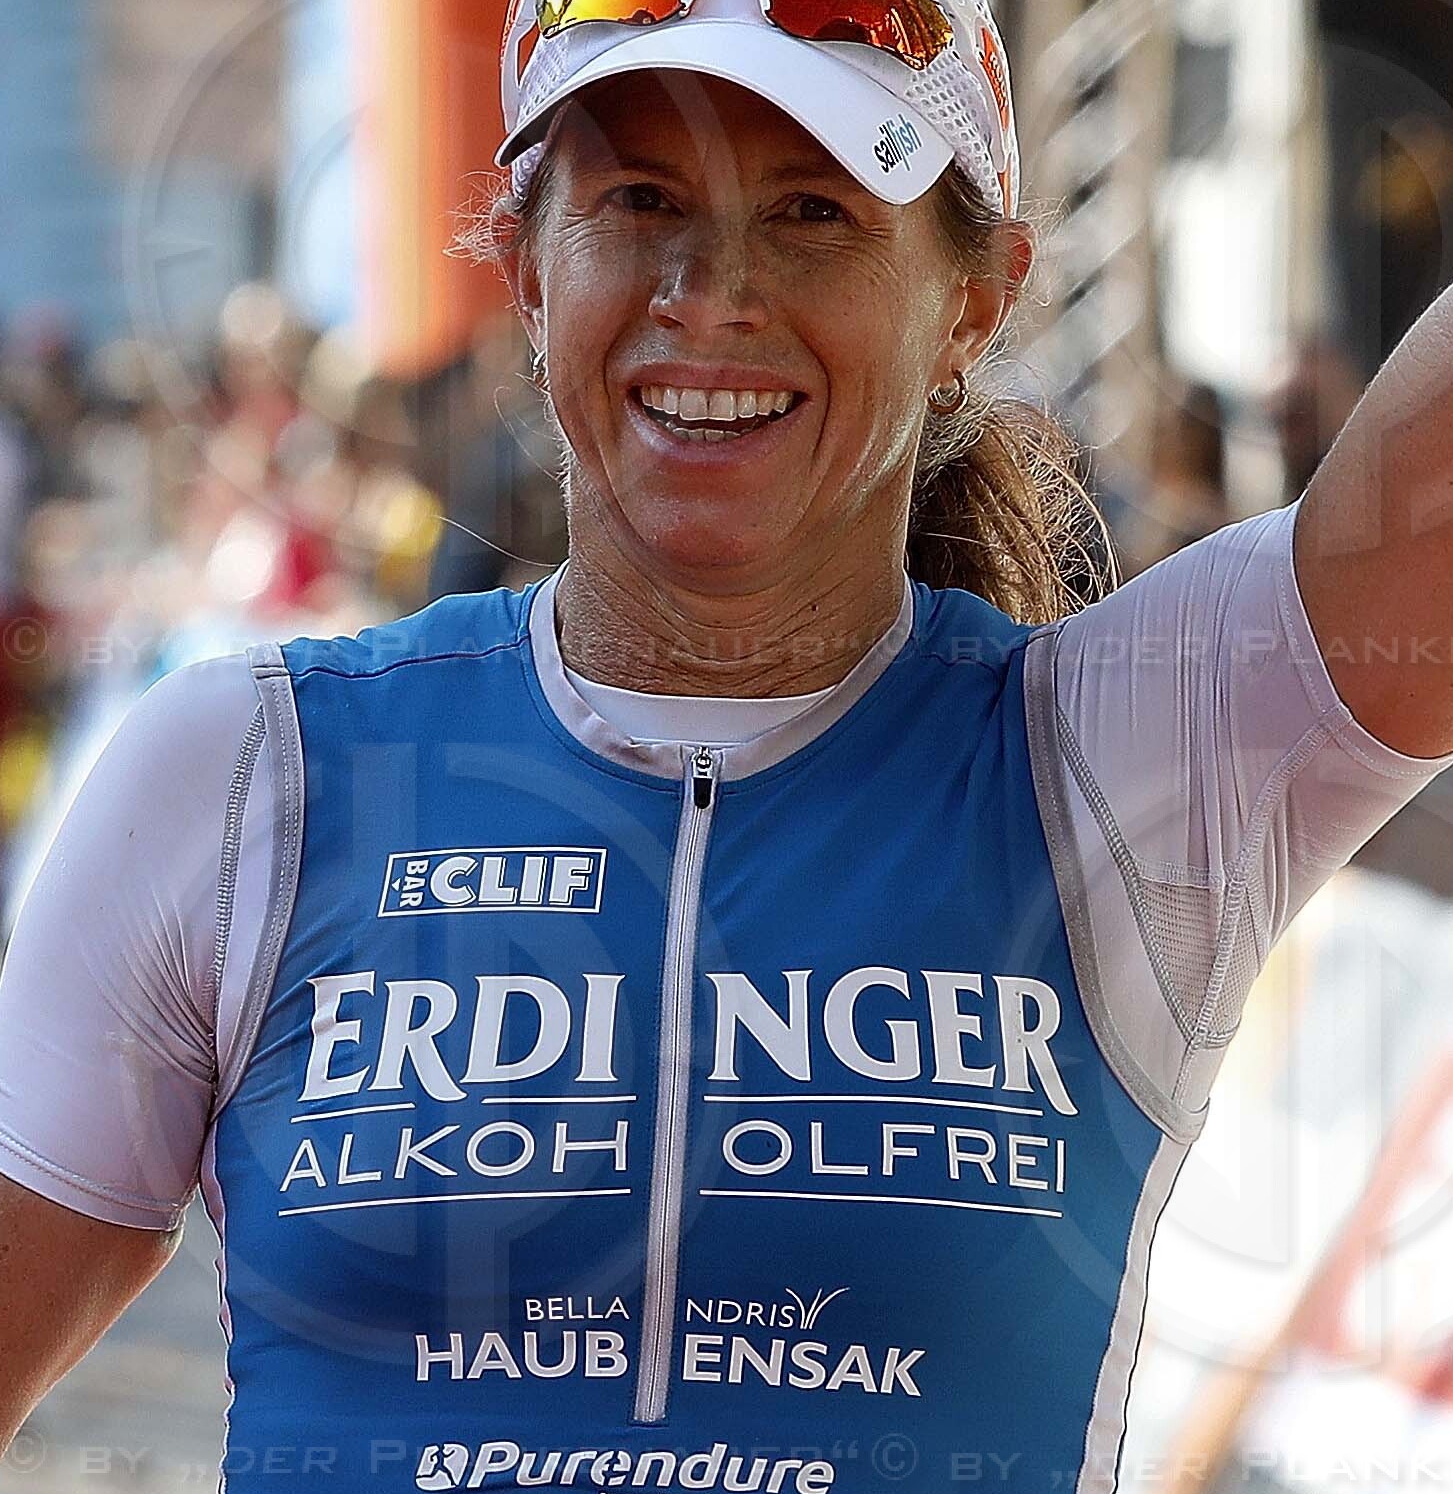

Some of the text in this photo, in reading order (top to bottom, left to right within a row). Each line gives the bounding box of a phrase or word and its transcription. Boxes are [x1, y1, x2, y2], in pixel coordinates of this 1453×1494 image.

[874, 113, 922, 173] sailfish
[399, 856, 594, 908] BAR CLIF
